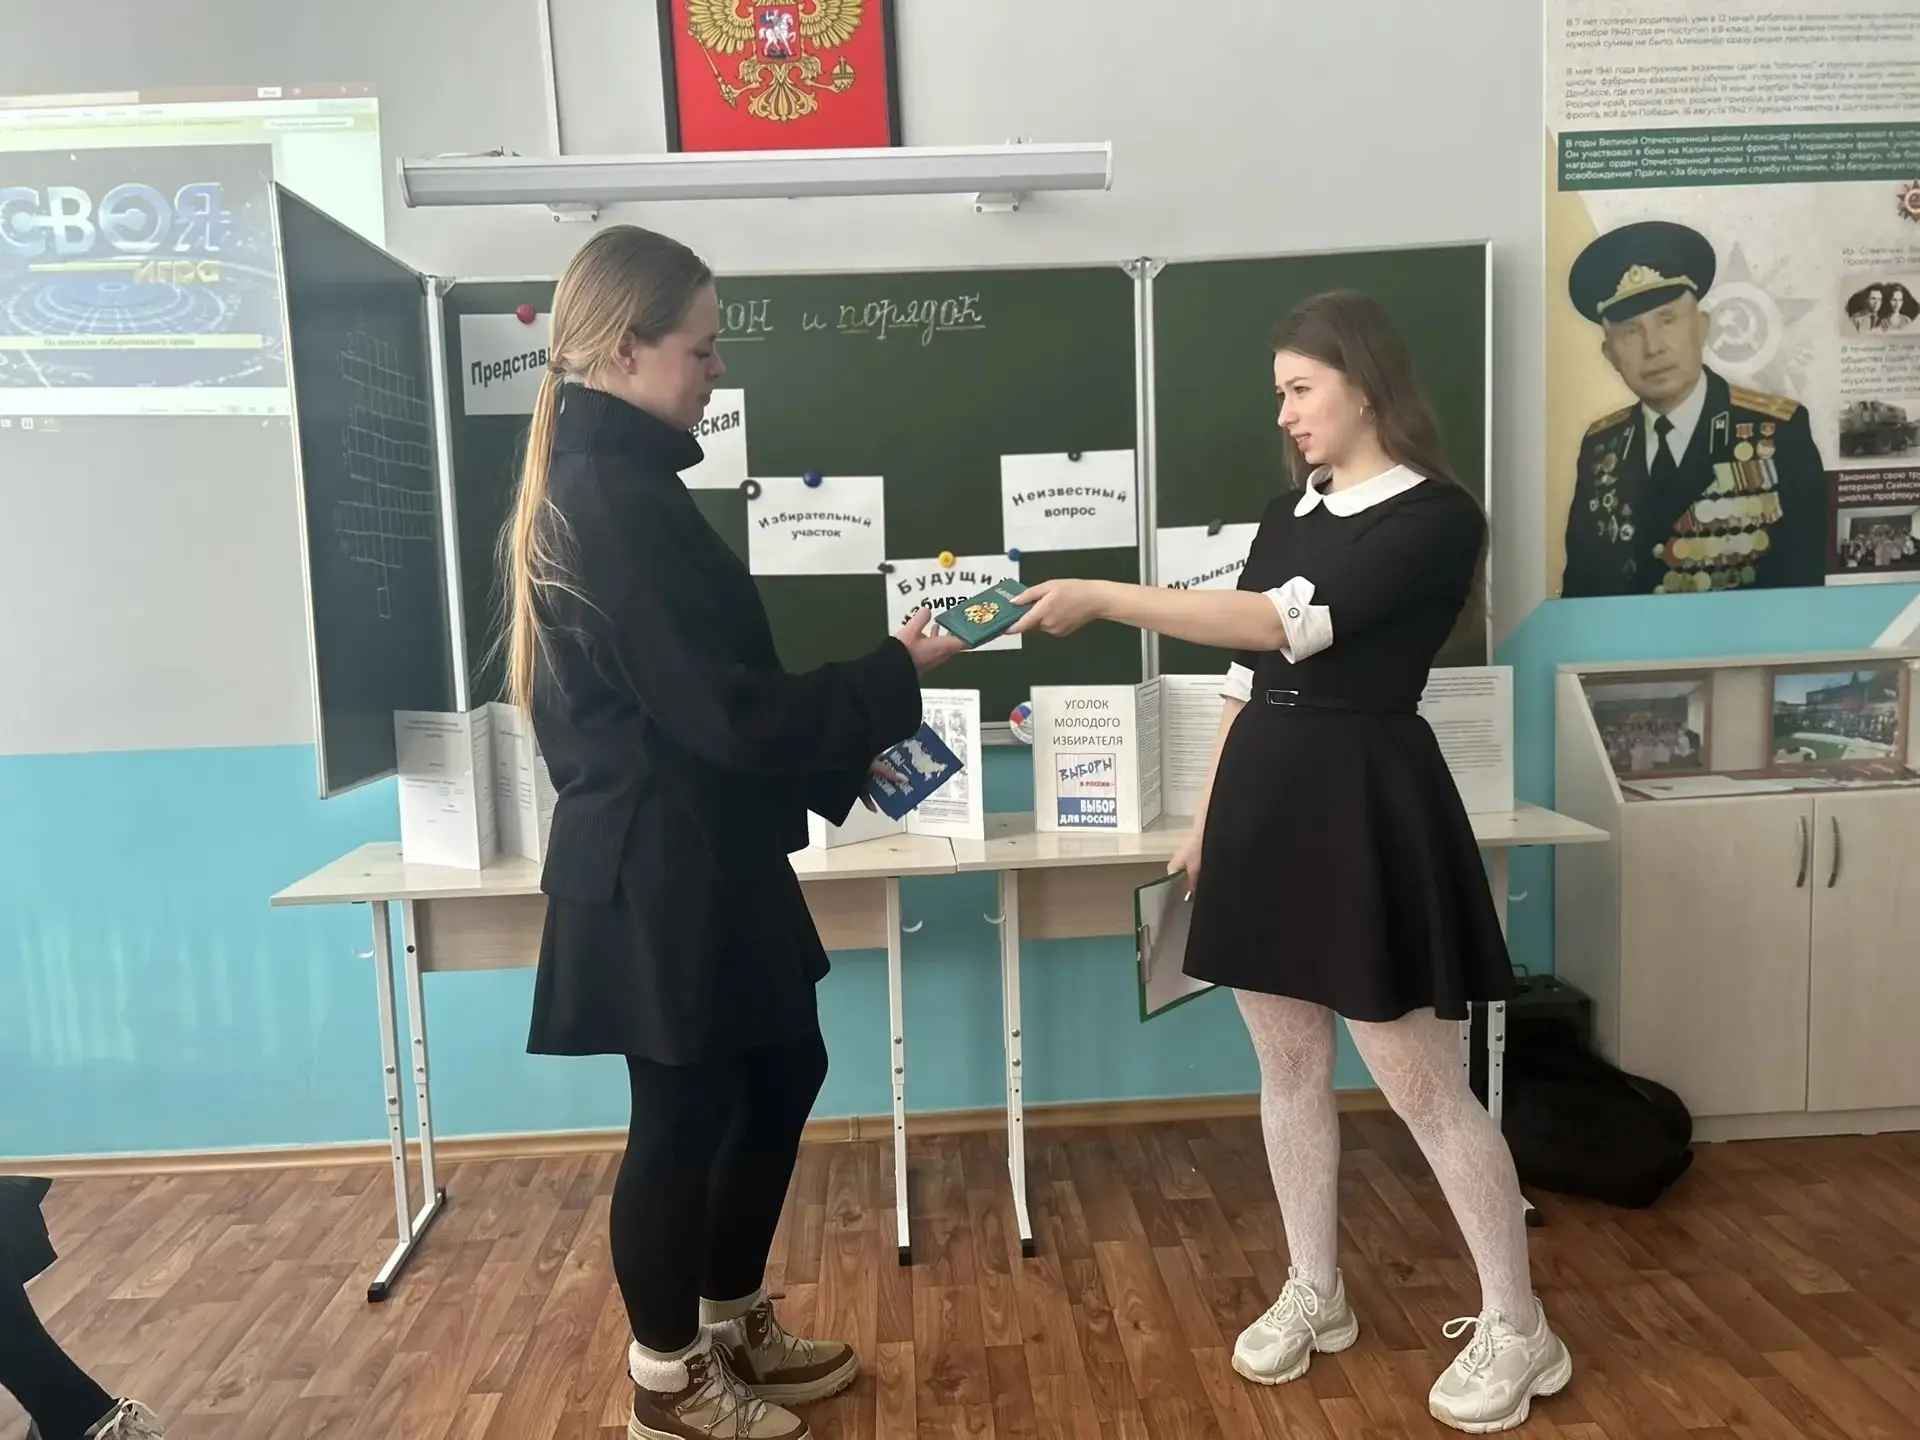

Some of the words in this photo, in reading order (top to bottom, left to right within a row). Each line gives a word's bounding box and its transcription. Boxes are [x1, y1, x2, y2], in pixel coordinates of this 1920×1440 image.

[1566, 139, 1572, 148] В
[1575, 140, 1596, 149] годы
[1599, 137, 1638, 146] Великой
[1640, 134, 1710, 145] Отечественной
[1711, 134, 1740, 142] войны
[1742, 133, 1791, 141] Александр
[1565, 150, 1579, 158] Он
[1582, 149, 1633, 159] участвовал
[1644, 146, 1665, 155] боях
[1682, 146, 1744, 154] Калининском
[1609, 160, 1638, 168] орден
[1641, 156, 1710, 166] Отечественной
[1565, 171, 1632, 180] освобождение
[1687, 166, 1747, 176] безупречную
[1748, 164, 1781, 174] службу
[0, 181, 224, 255] СВОЯ
[802, 312, 827, 331] и
[837, 292, 983, 346] порядок
[471, 347, 551, 388] Представ
[688, 410, 740, 439] еская
[1012, 486, 1127, 506] Неизвестный
[758, 512, 872, 528] Избирательный
[1044, 507, 1096, 518] вопрос
[792, 528, 841, 540] участок
[897, 571, 1006, 596] Будущи
[901, 596, 972, 626] избира
[1064, 700, 1109, 710] УГОЛОК
[1054, 718, 1120, 728] МОЛОДОГО
[1053, 736, 1123, 746] ИЗБИРАТЕЛЯ
[1058, 758, 1112, 781] ВЫБОРЫ
[1080, 799, 1116, 814] ВЫБОР
[1060, 814, 1080, 824] ДЛЯ
[1080, 814, 1116, 824] РОССИИ
